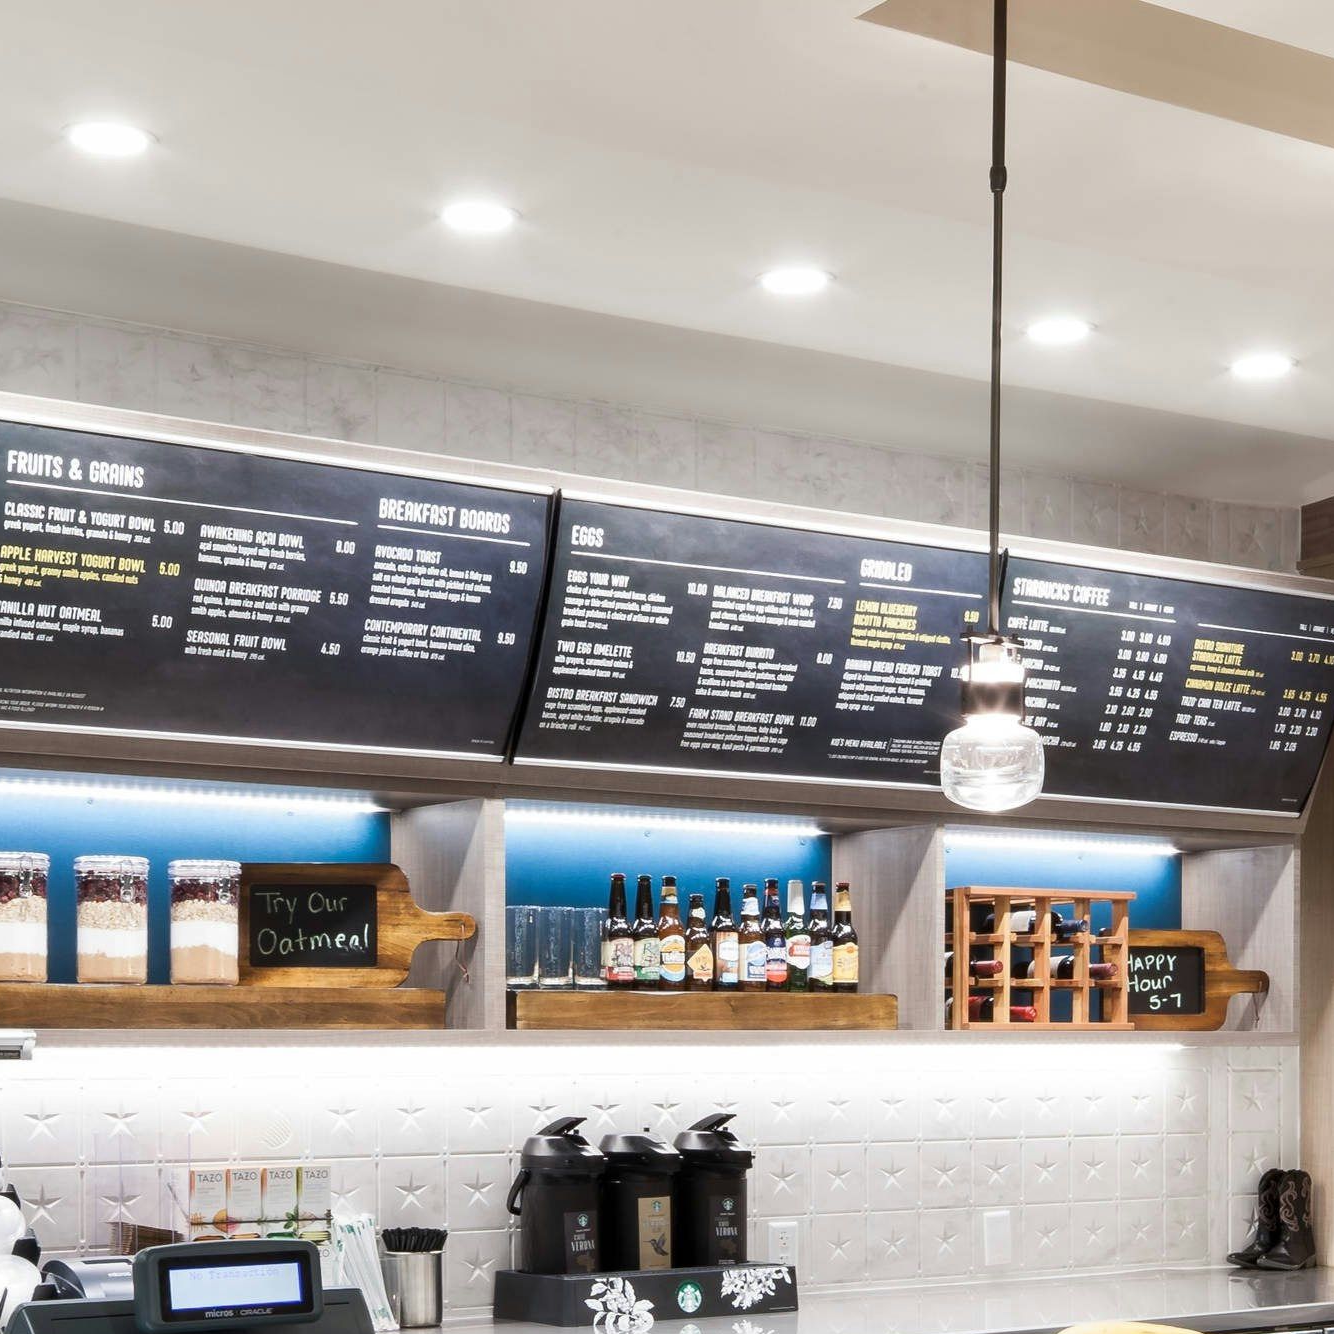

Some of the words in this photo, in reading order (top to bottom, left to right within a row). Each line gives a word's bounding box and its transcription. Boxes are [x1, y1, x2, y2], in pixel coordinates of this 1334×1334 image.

[7, 450, 63, 478] FRUITS
[68, 458, 82, 481] &
[89, 461, 144, 488] GRAINS
[5, 502, 45, 519] CLASSIC
[48, 507, 76, 523] FRUIT
[78, 511, 87, 524] &
[91, 513, 125, 528] YOGURT
[128, 516, 156, 532] BOWL
[164, 520, 185, 535] 5.00
[379, 498, 456, 527] BREAKFAST
[460, 508, 510, 534] BOARDS
[201, 525, 253, 543] AWAKENING
[279, 534, 304, 548] BOWL
[336, 540, 355, 554] 8.00
[571, 525, 604, 547] EGGS
[0, 545, 32, 560] APPLE
[35, 549, 77, 565] HARVEST
[81, 554, 116, 569] YOGURT
[119, 558, 146, 573] BOWL
[160, 562, 180, 576] 5.00
[375, 545, 413, 561] AVOCADO
[416, 549, 442, 564] TOAST
[510, 561, 527, 575] 9.50
[860, 559, 912, 581] GRIDDLED
[195, 578, 226, 593] QUINOA
[229, 582, 279, 598] BREAKFAST
[281, 586, 322, 603] PORRIDGE
[330, 592, 349, 605] 5.50
[567, 570, 587, 583] EGGS
[590, 573, 610, 586] YOUR
[612, 575, 629, 588] WAY
[687, 583, 707, 596] 10.00
[751, 589, 791, 604] BREAKFAST
[1073, 585, 1110, 606] COFFEE
[37, 604, 56, 618] NUT
[59, 606, 102, 622] OATMEAL
[152, 615, 173, 629] 5.00
[364, 619, 427, 636] CONTEMPORARY
[430, 626, 481, 642] CONTINENTAL
[497, 632, 515, 645] 9.50
[187, 630, 230, 646] SEASONAL
[234, 634, 260, 648] FRUIT
[261, 637, 286, 651] BOWL
[321, 642, 340, 656] 4.50
[558, 640, 575, 653] TWO
[577, 642, 591, 654] EGG
[593, 644, 633, 658] OMELETTE
[676, 651, 696, 663] 10.50
[703, 643, 744, 657] BREAKFAST
[895, 664, 921, 675] FRENCH
[922, 666, 942, 677] TOAST
[547, 687, 574, 700] BISTRO
[575, 690, 618, 703] BREAKFAST
[619, 693, 658, 706] SANDWICH
[670, 697, 686, 708] 7.50
[689, 708, 709, 719] FARM
[711, 710, 733, 721] STAND
[734, 711, 774, 724] BREAKFAST
[775, 715, 794, 725] BOWL
[800, 716, 817, 727] 11.00
[1169, 731, 1198, 743] ESPRESSO
[255, 892, 297, 924] Try
[308, 892, 347, 913] Our
[258, 924, 368, 954] Oatmeal
[1127, 954, 1176, 972] HAPPY
[1127, 974, 1172, 992] Hour
[1150, 993, 1181, 1009] 5-7
[198, 1174, 222, 1183] TAZO
[233, 1172, 257, 1180] TAZO
[269, 1171, 293, 1179] TAZO
[305, 1171, 328, 1179] TAZO
[189, 1272, 202, 1280] No
[205, 1310, 233, 1318] micros
